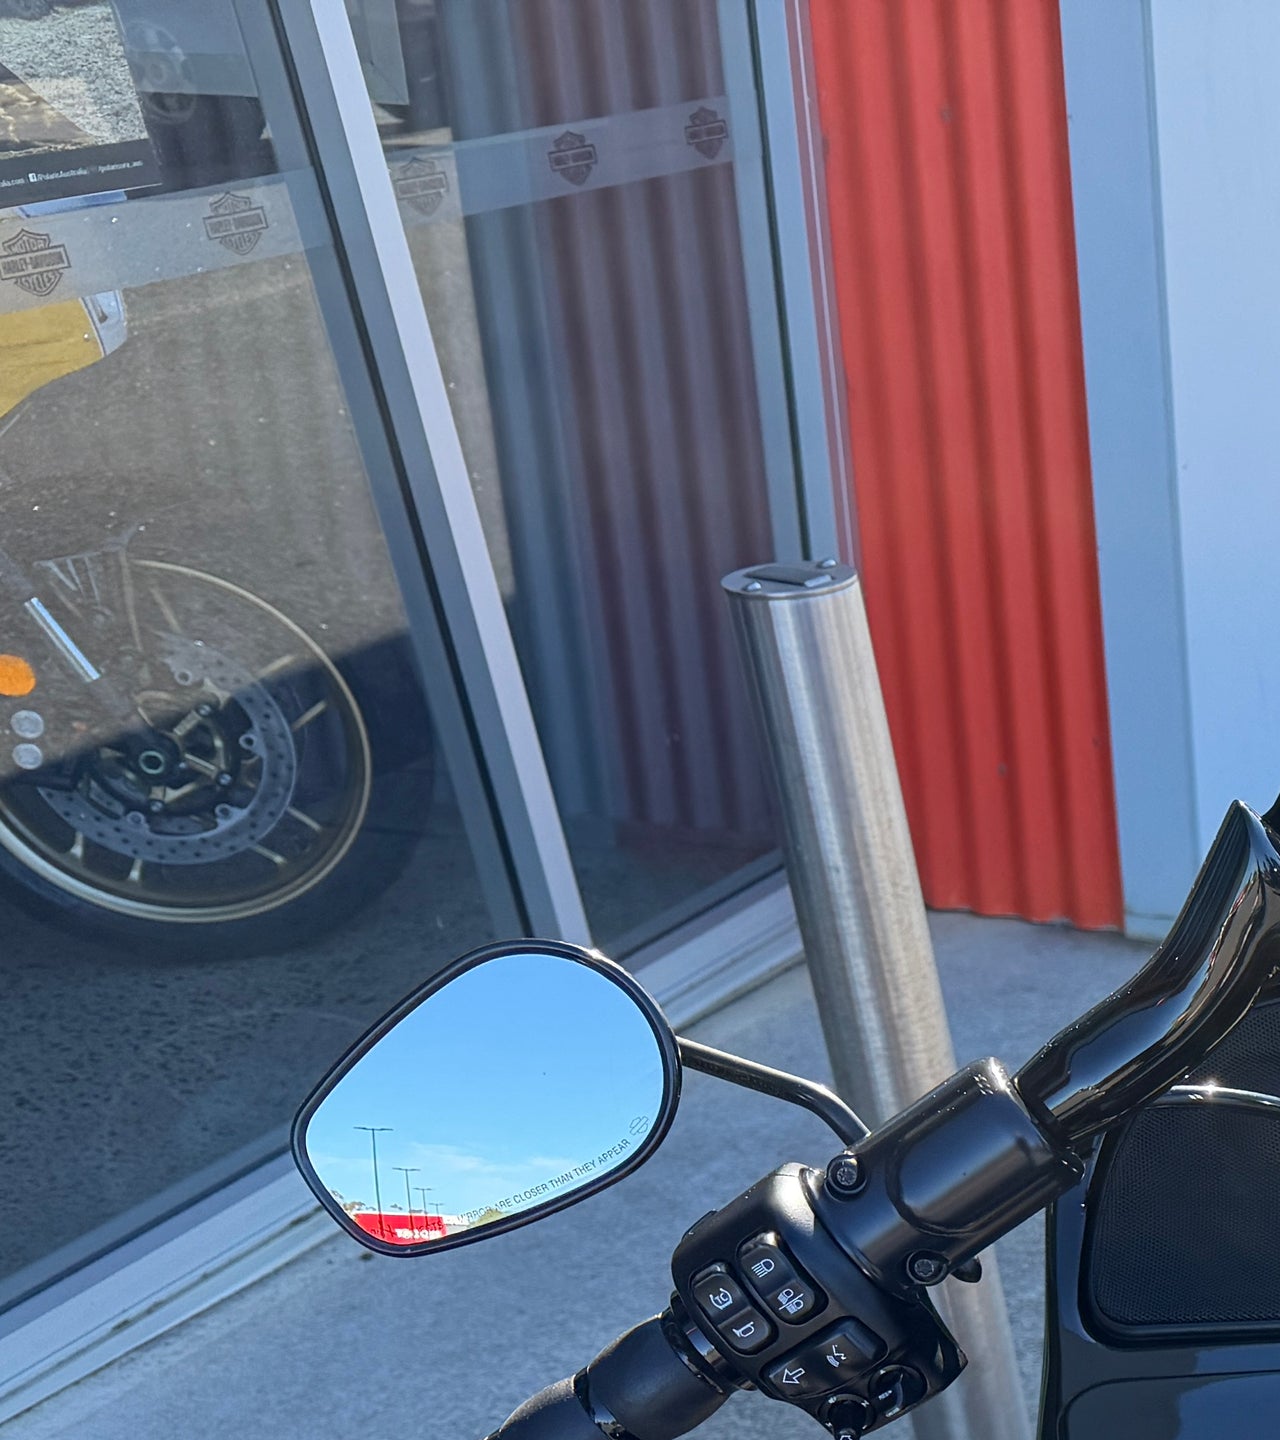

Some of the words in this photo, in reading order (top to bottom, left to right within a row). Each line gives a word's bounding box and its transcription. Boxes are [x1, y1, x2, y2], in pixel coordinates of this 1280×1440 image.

[513, 1183, 549, 1204] CLOSER
[549, 1172, 574, 1190] THAN
[573, 1160, 597, 1181] THEY
[598, 1138, 631, 1165] APPEAR
[714, 1292, 729, 1304] TC
